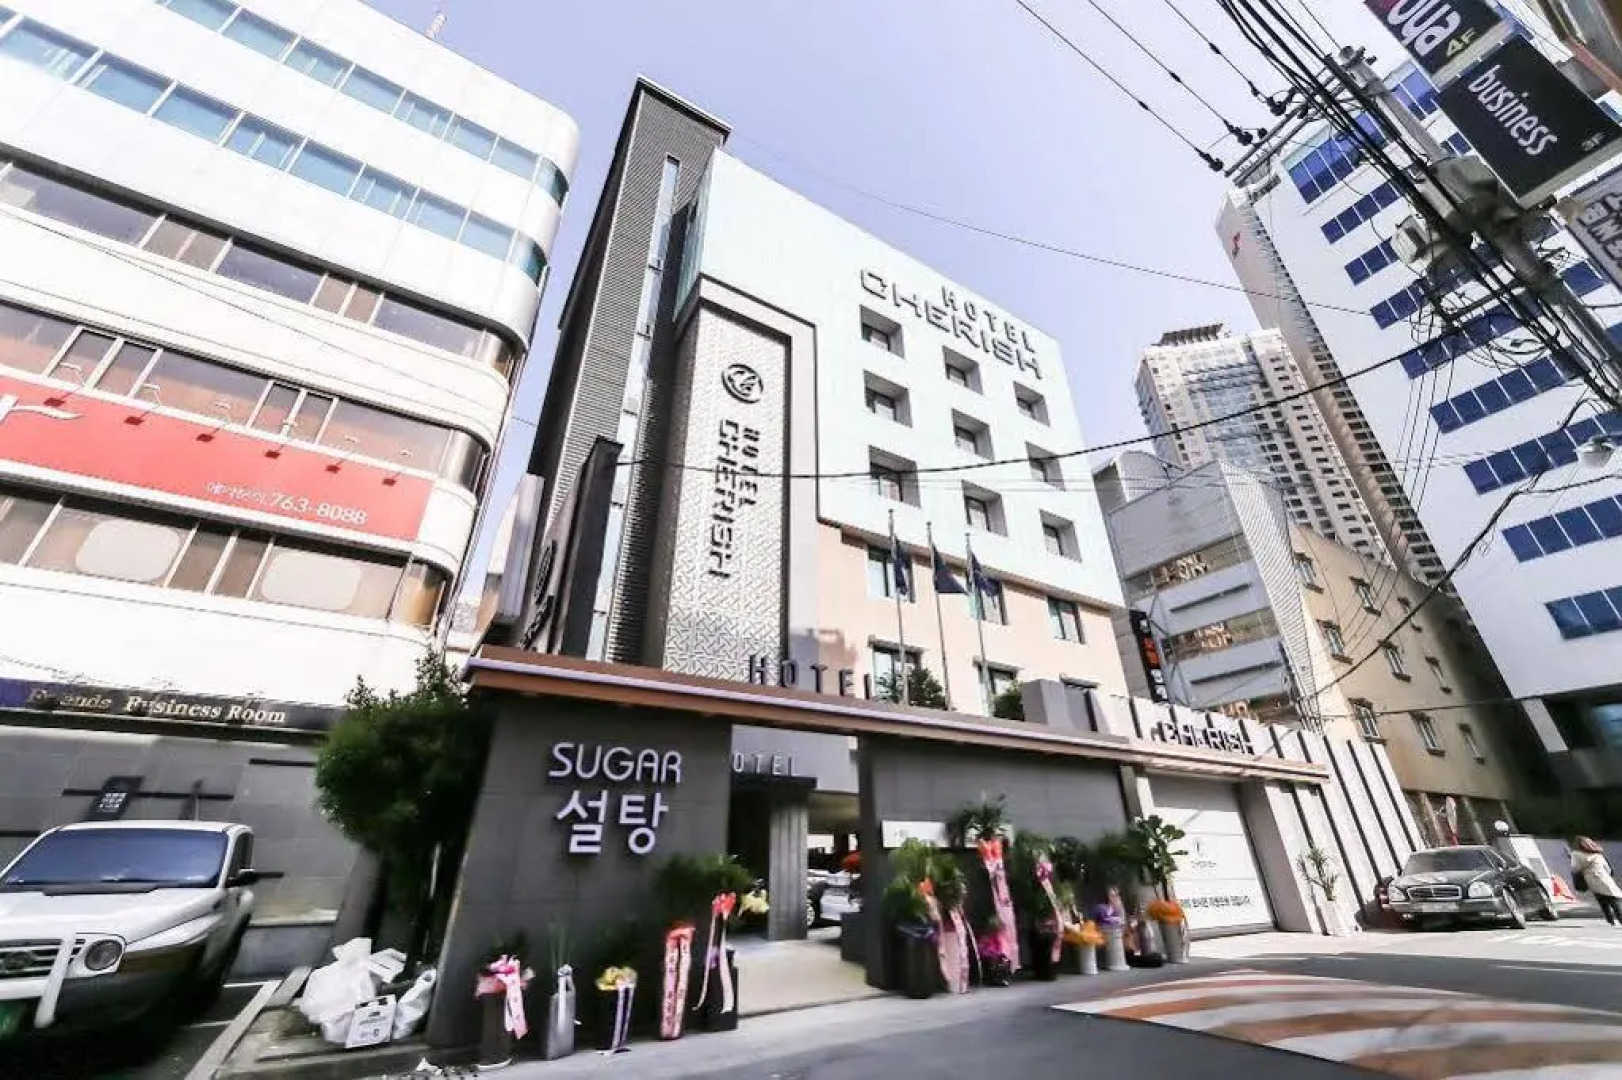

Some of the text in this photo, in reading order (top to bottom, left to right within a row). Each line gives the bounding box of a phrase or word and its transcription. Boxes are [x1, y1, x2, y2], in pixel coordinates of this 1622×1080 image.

[1446, 27, 1477, 57] 4F
[1467, 64, 1557, 157] business
[860, 268, 1043, 380] CHERISH
[941, 285, 1035, 353] HOTEL
[708, 418, 740, 580] CHERISH
[739, 427, 760, 508] HOTEL
[227, 704, 286, 724] Room
[550, 742, 683, 783] SUGAR
[556, 789, 669, 854] 설탕
